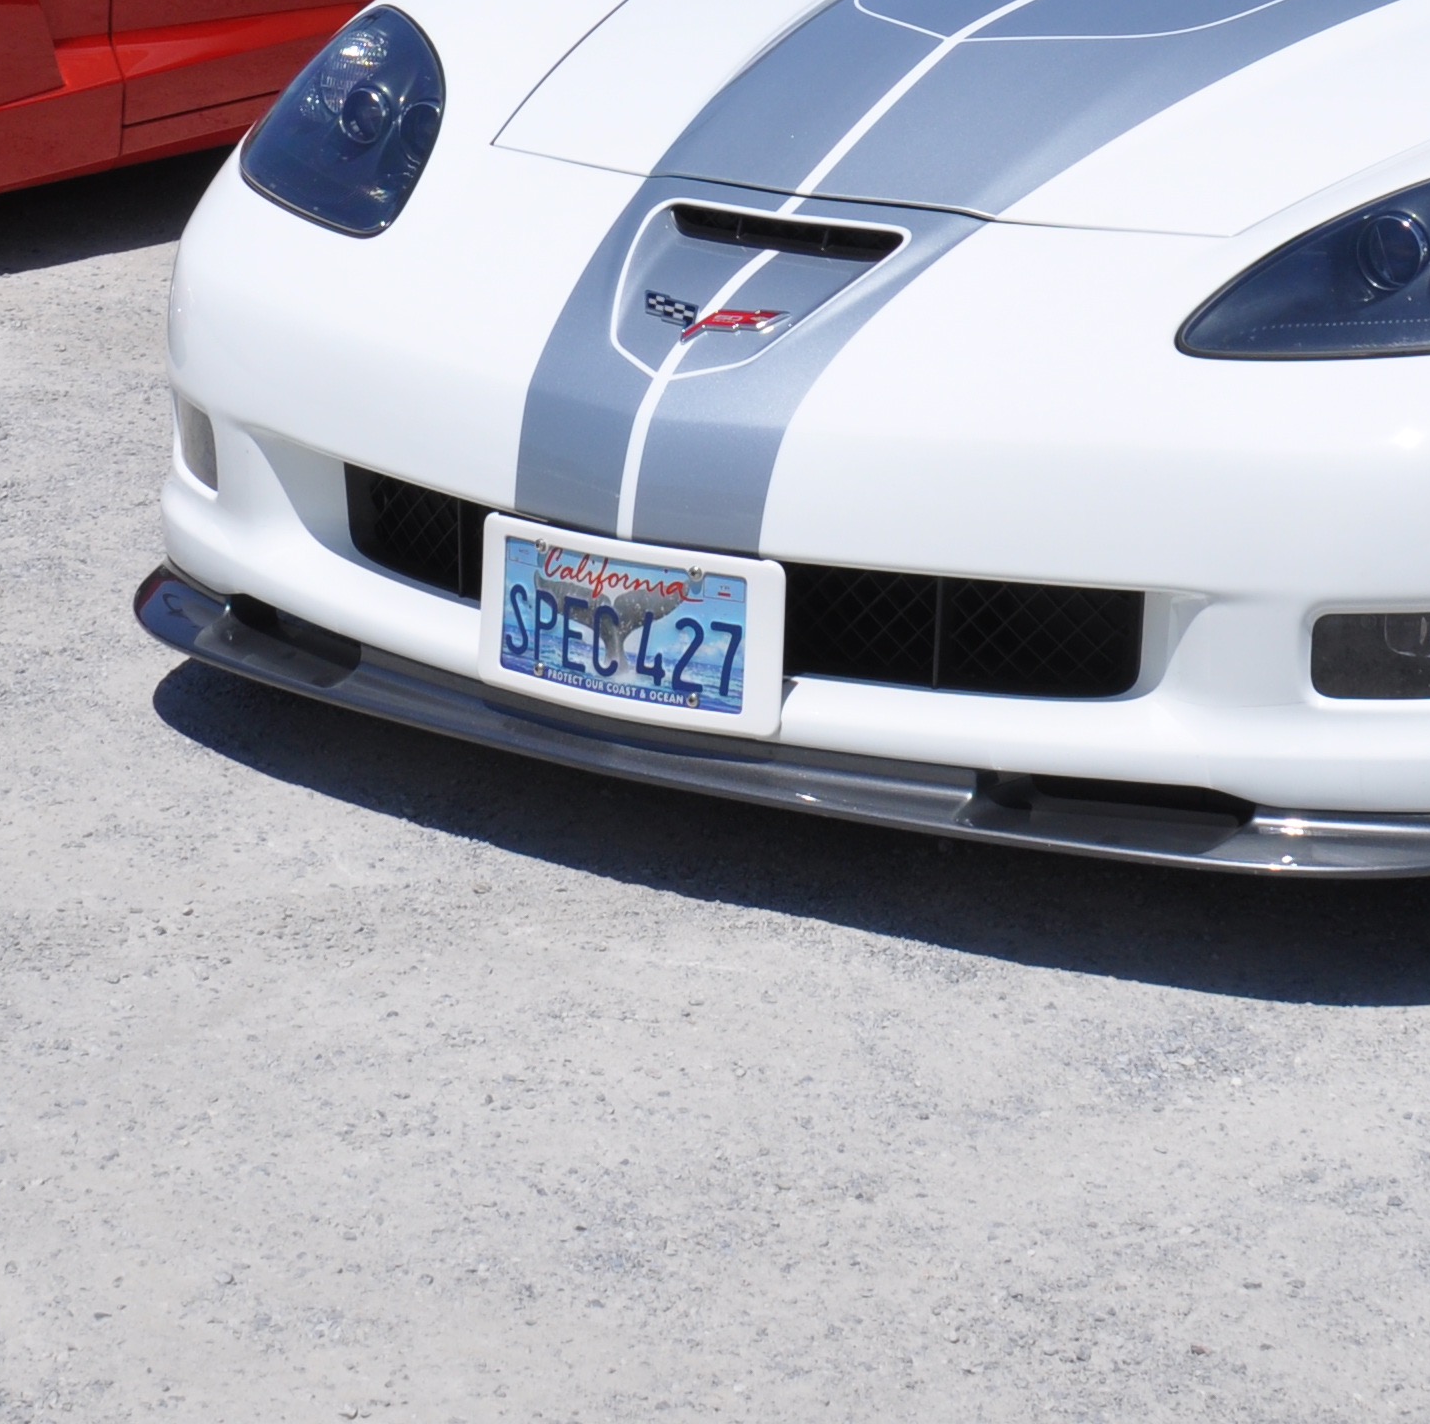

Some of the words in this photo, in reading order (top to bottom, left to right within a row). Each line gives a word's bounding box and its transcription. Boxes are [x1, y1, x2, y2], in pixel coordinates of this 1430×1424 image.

[543, 546, 704, 602] California
[505, 583, 619, 677] SPEC
[635, 611, 744, 697] 427
[547, 668, 583, 687] PROTECT
[585, 678, 604, 691] OUR
[606, 683, 637, 697] COAST
[639, 689, 646, 699] &
[649, 691, 684, 705] OCEAN
